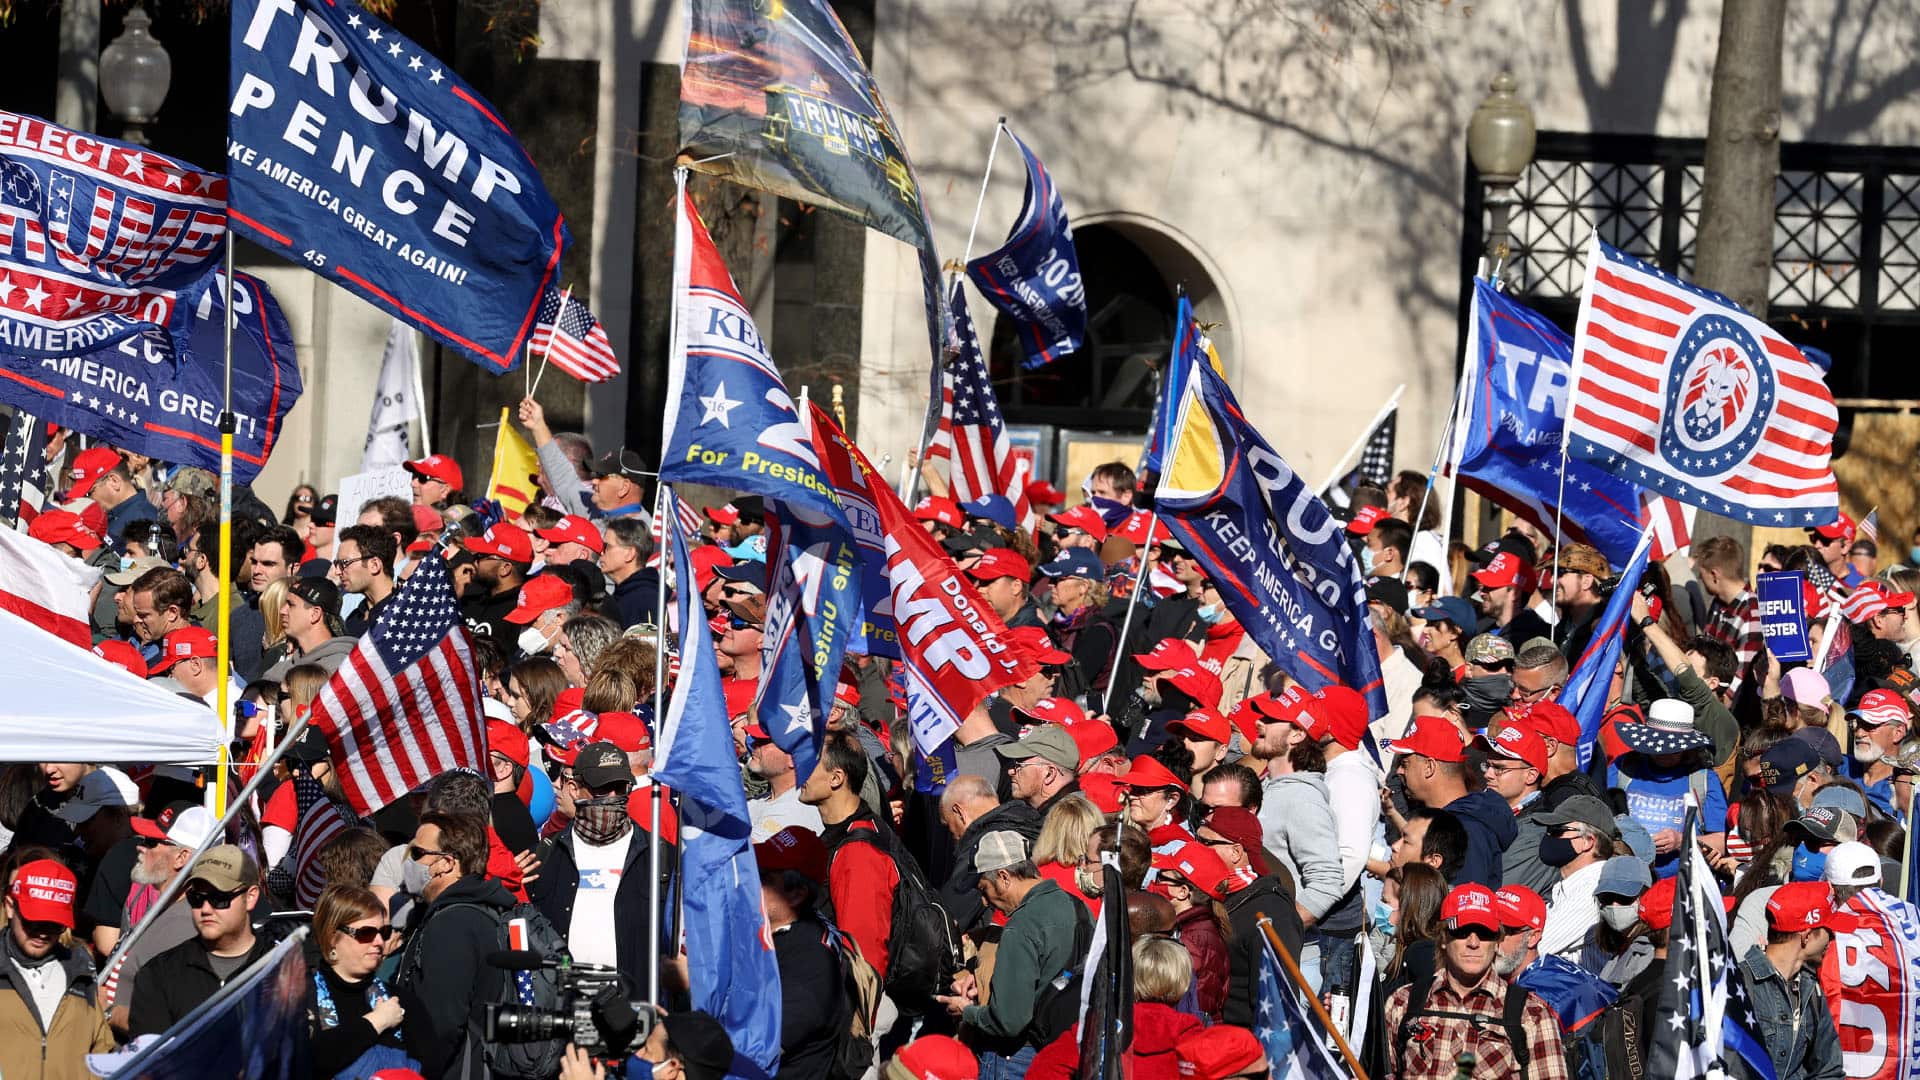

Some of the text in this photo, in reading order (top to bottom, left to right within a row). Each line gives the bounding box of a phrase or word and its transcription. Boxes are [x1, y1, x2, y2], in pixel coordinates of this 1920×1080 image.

[243, 0, 521, 203] TRUMP
[787, 96, 879, 145] TRUMP
[230, 72, 476, 247] PENCE
[0, 160, 228, 288] RUMP
[256, 158, 340, 214] AMERICA
[343, 206, 398, 250] GREAT
[399, 243, 468, 285] AGAIN!
[303, 248, 327, 267] 45
[159, 390, 257, 439] GRET!
[686, 444, 729, 466] For
[1204, 510, 1257, 564] KEEP
[1254, 561, 1314, 637] AMERICA
[941, 575, 1019, 674] Donald J.
[1627, 793, 1685, 811] TRUMP
[1805, 909, 1821, 924] 45
